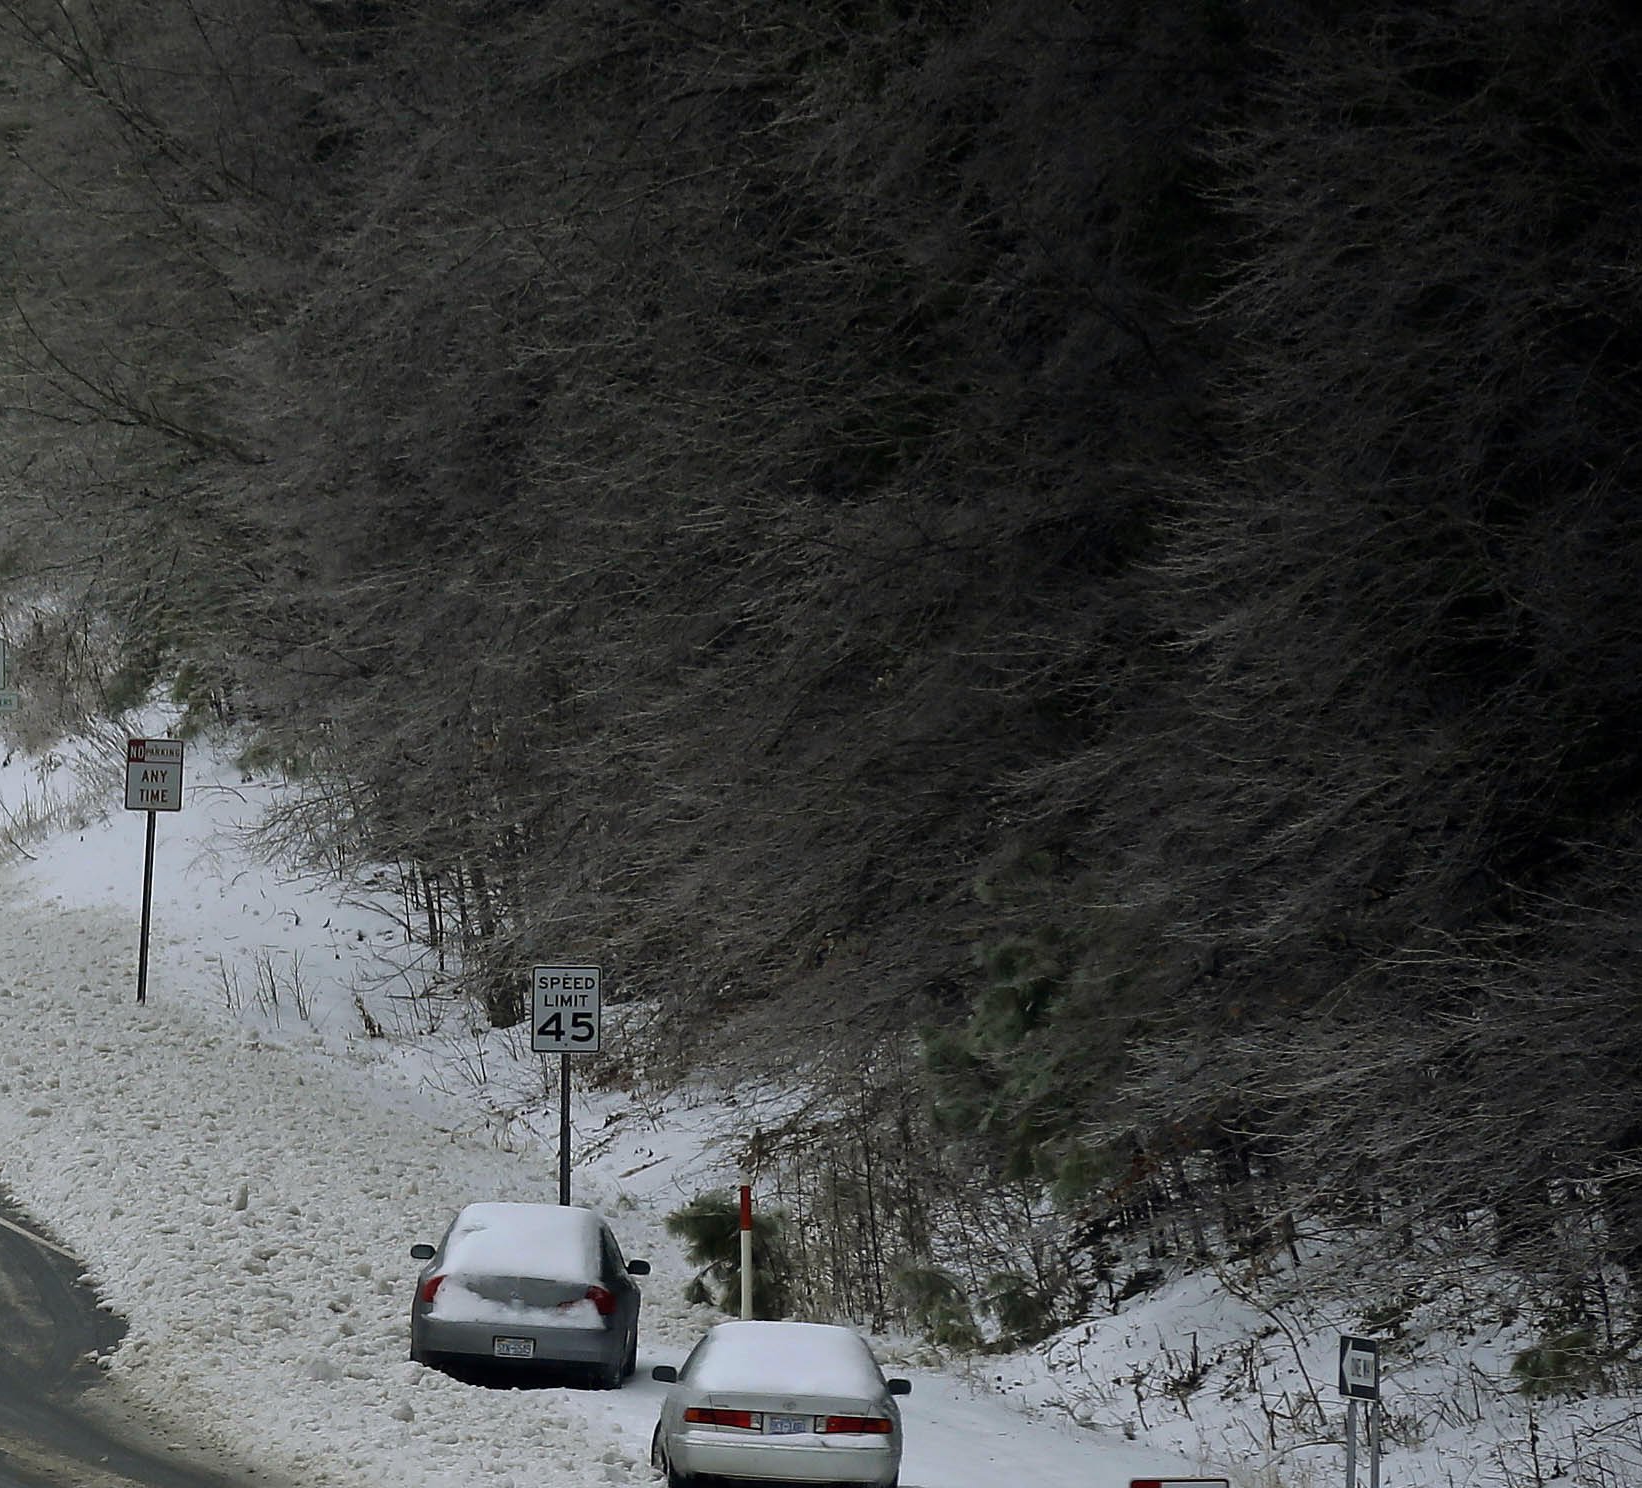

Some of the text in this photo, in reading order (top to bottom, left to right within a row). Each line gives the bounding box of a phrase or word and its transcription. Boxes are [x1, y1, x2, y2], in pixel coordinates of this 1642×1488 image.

[130, 745, 181, 759] NO PARKING
[142, 769, 168, 783] ANY
[139, 788, 169, 803] TIME
[539, 976, 595, 990] SPEED
[544, 994, 588, 1007] LIMIT
[537, 1012, 595, 1042] 45
